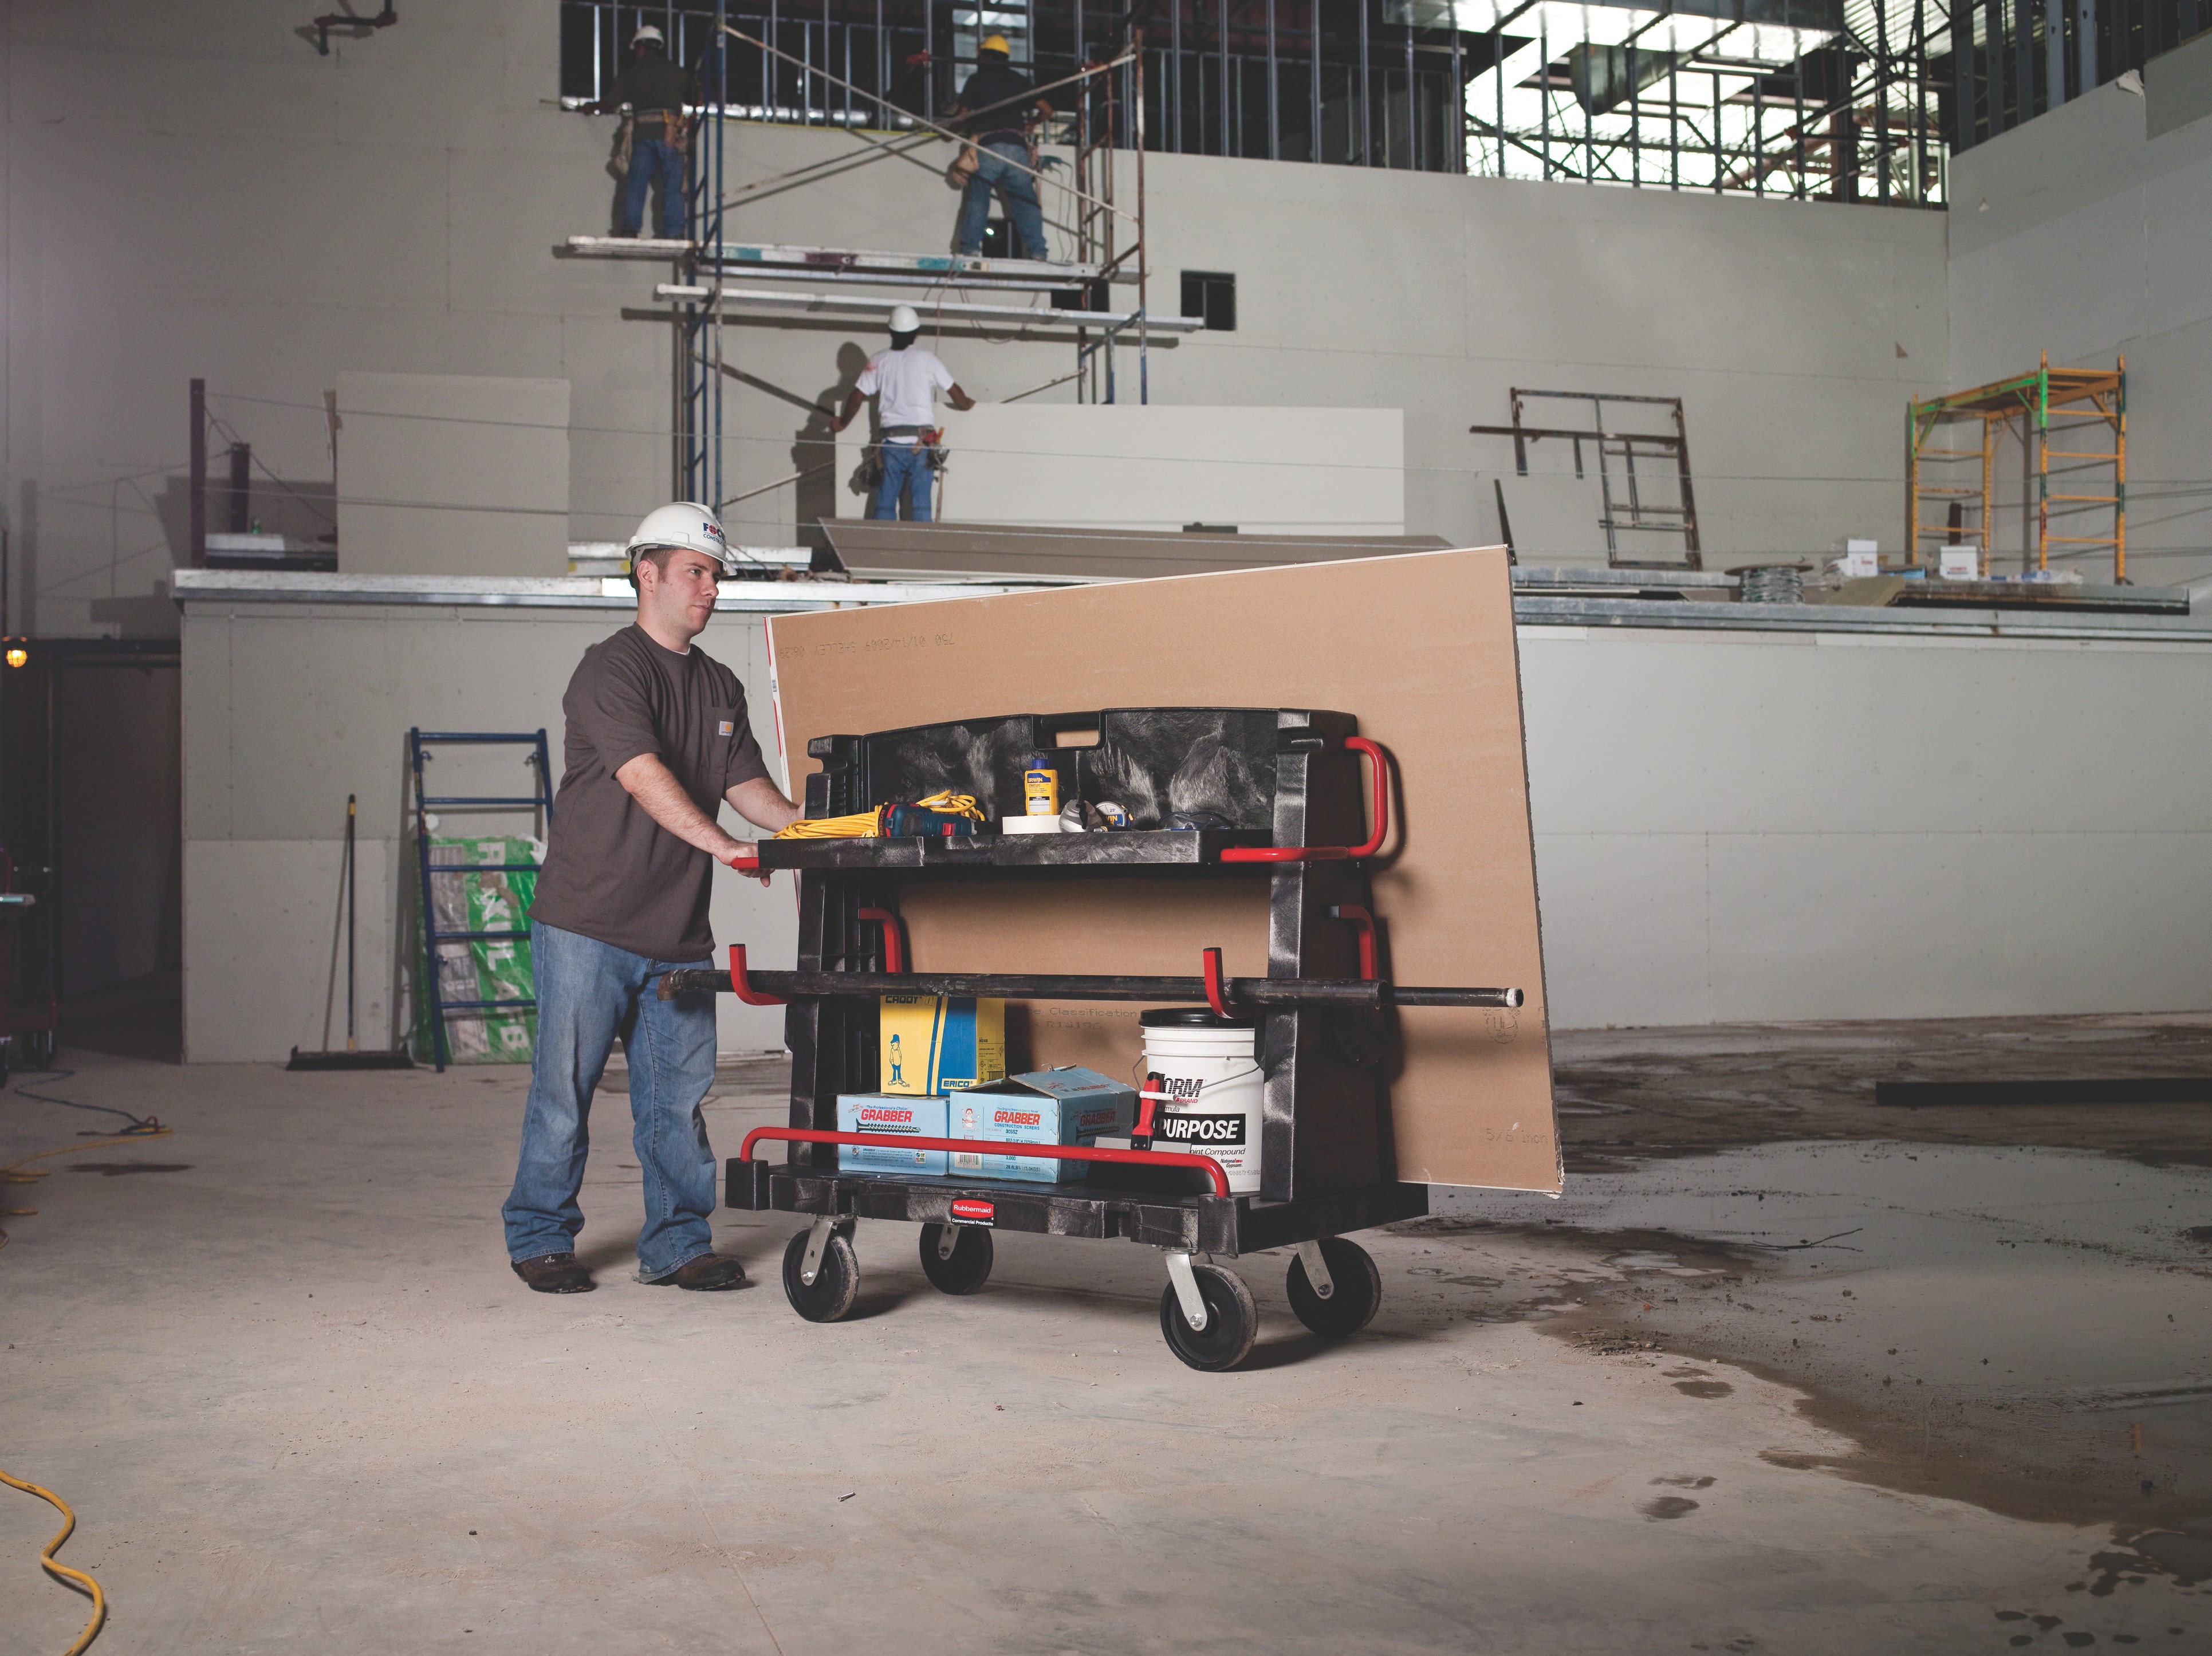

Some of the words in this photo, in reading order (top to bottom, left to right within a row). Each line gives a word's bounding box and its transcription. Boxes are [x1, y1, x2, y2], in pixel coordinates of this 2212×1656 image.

[885, 996, 919, 1004] CADDY
[1049, 1007, 1137, 1017] Classification
[1162, 1073, 1203, 1098] ORM
[861, 1109, 912, 1122] GRABBER
[994, 1111, 1040, 1125] GRABBER
[1080, 1111, 1116, 1127] GRABBER
[1159, 1119, 1239, 1139] PURPOSE
[1205, 1148, 1246, 1156] Compound
[954, 1204, 991, 1213] Rubbermaid
